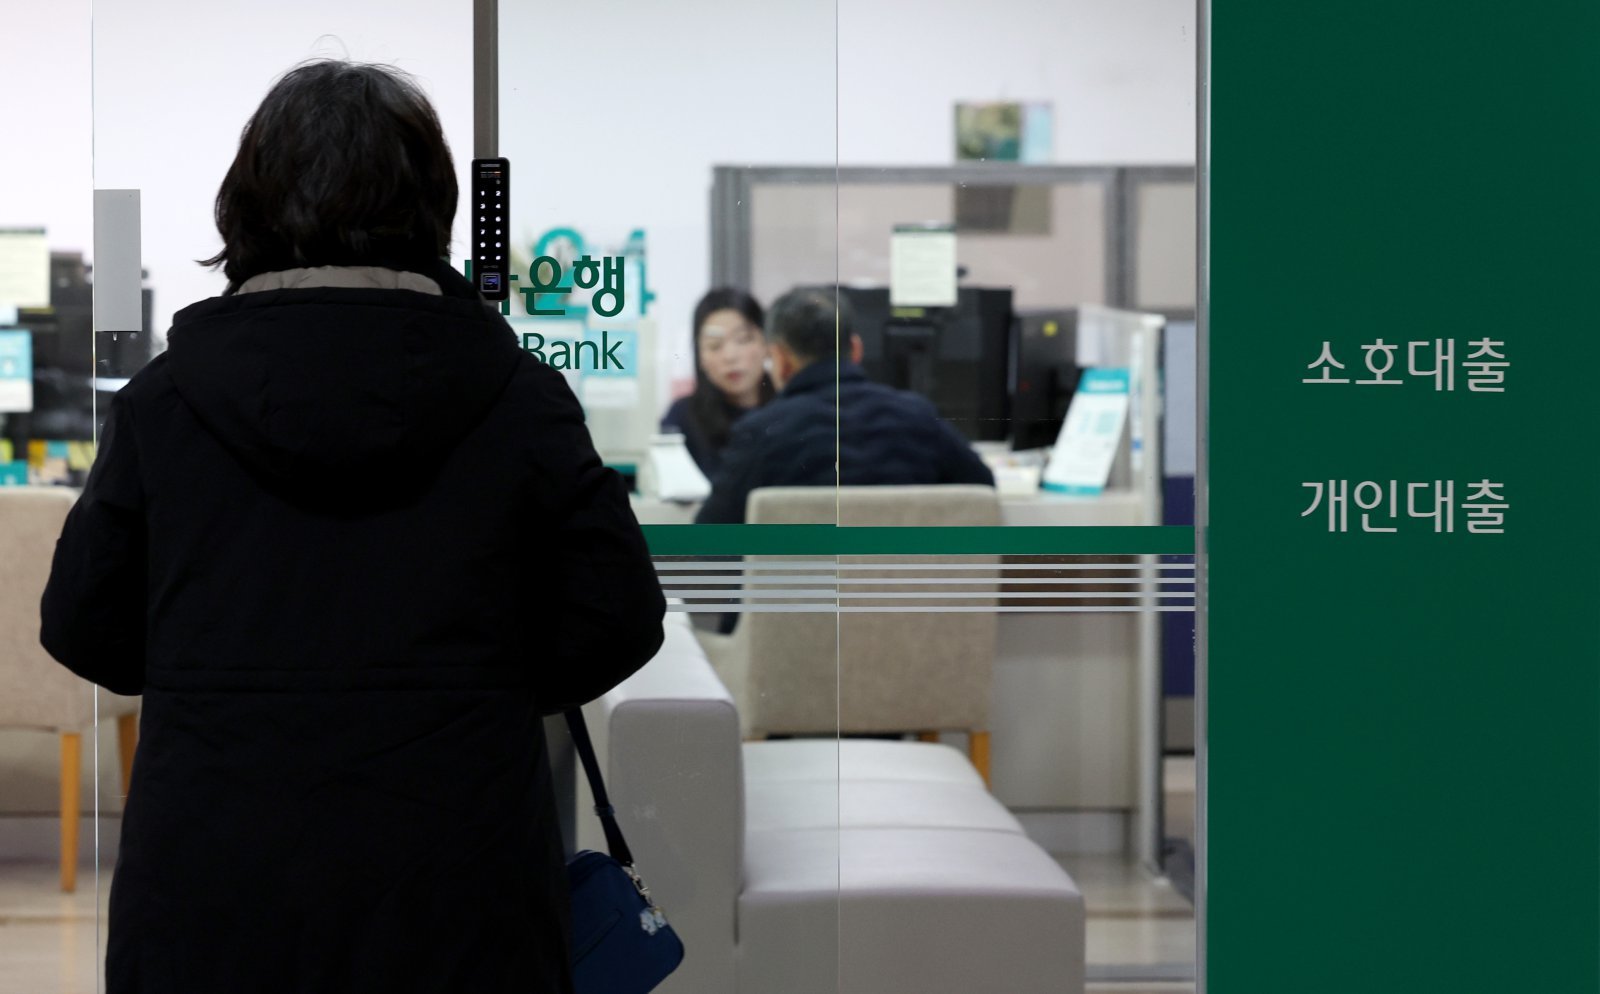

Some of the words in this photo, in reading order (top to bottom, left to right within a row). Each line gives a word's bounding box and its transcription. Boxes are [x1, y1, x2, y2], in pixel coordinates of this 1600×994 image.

[522, 331, 625, 371] Bank
[1302, 337, 1511, 393] 소호대출
[1301, 479, 1510, 534] 개인대출
